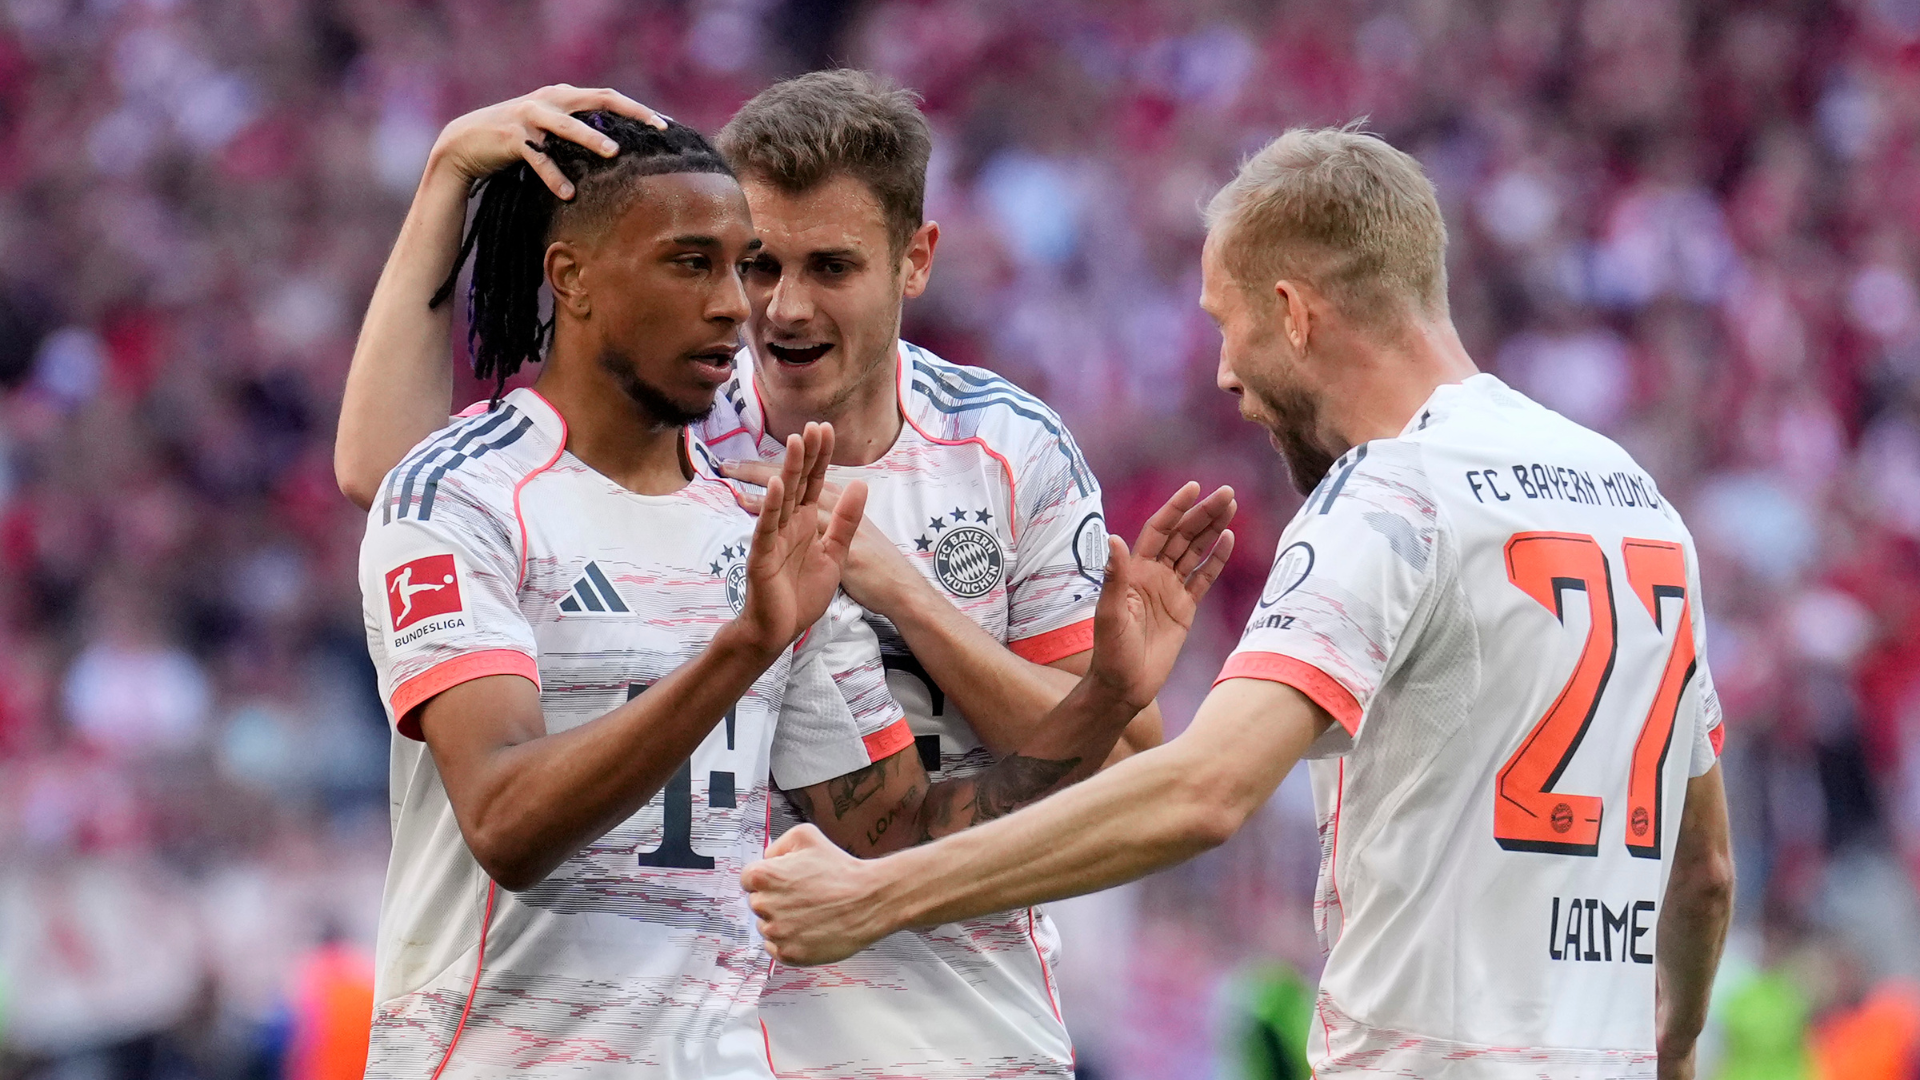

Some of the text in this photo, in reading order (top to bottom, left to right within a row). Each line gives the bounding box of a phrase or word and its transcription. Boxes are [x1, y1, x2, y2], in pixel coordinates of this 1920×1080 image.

[1466, 464, 1667, 514] FC BAYERN MÜNC
[939, 531, 997, 561] FC BAYERN
[729, 574, 739, 590] FC
[394, 618, 465, 648] BUNDESLIGA
[1494, 531, 1697, 859] 27
